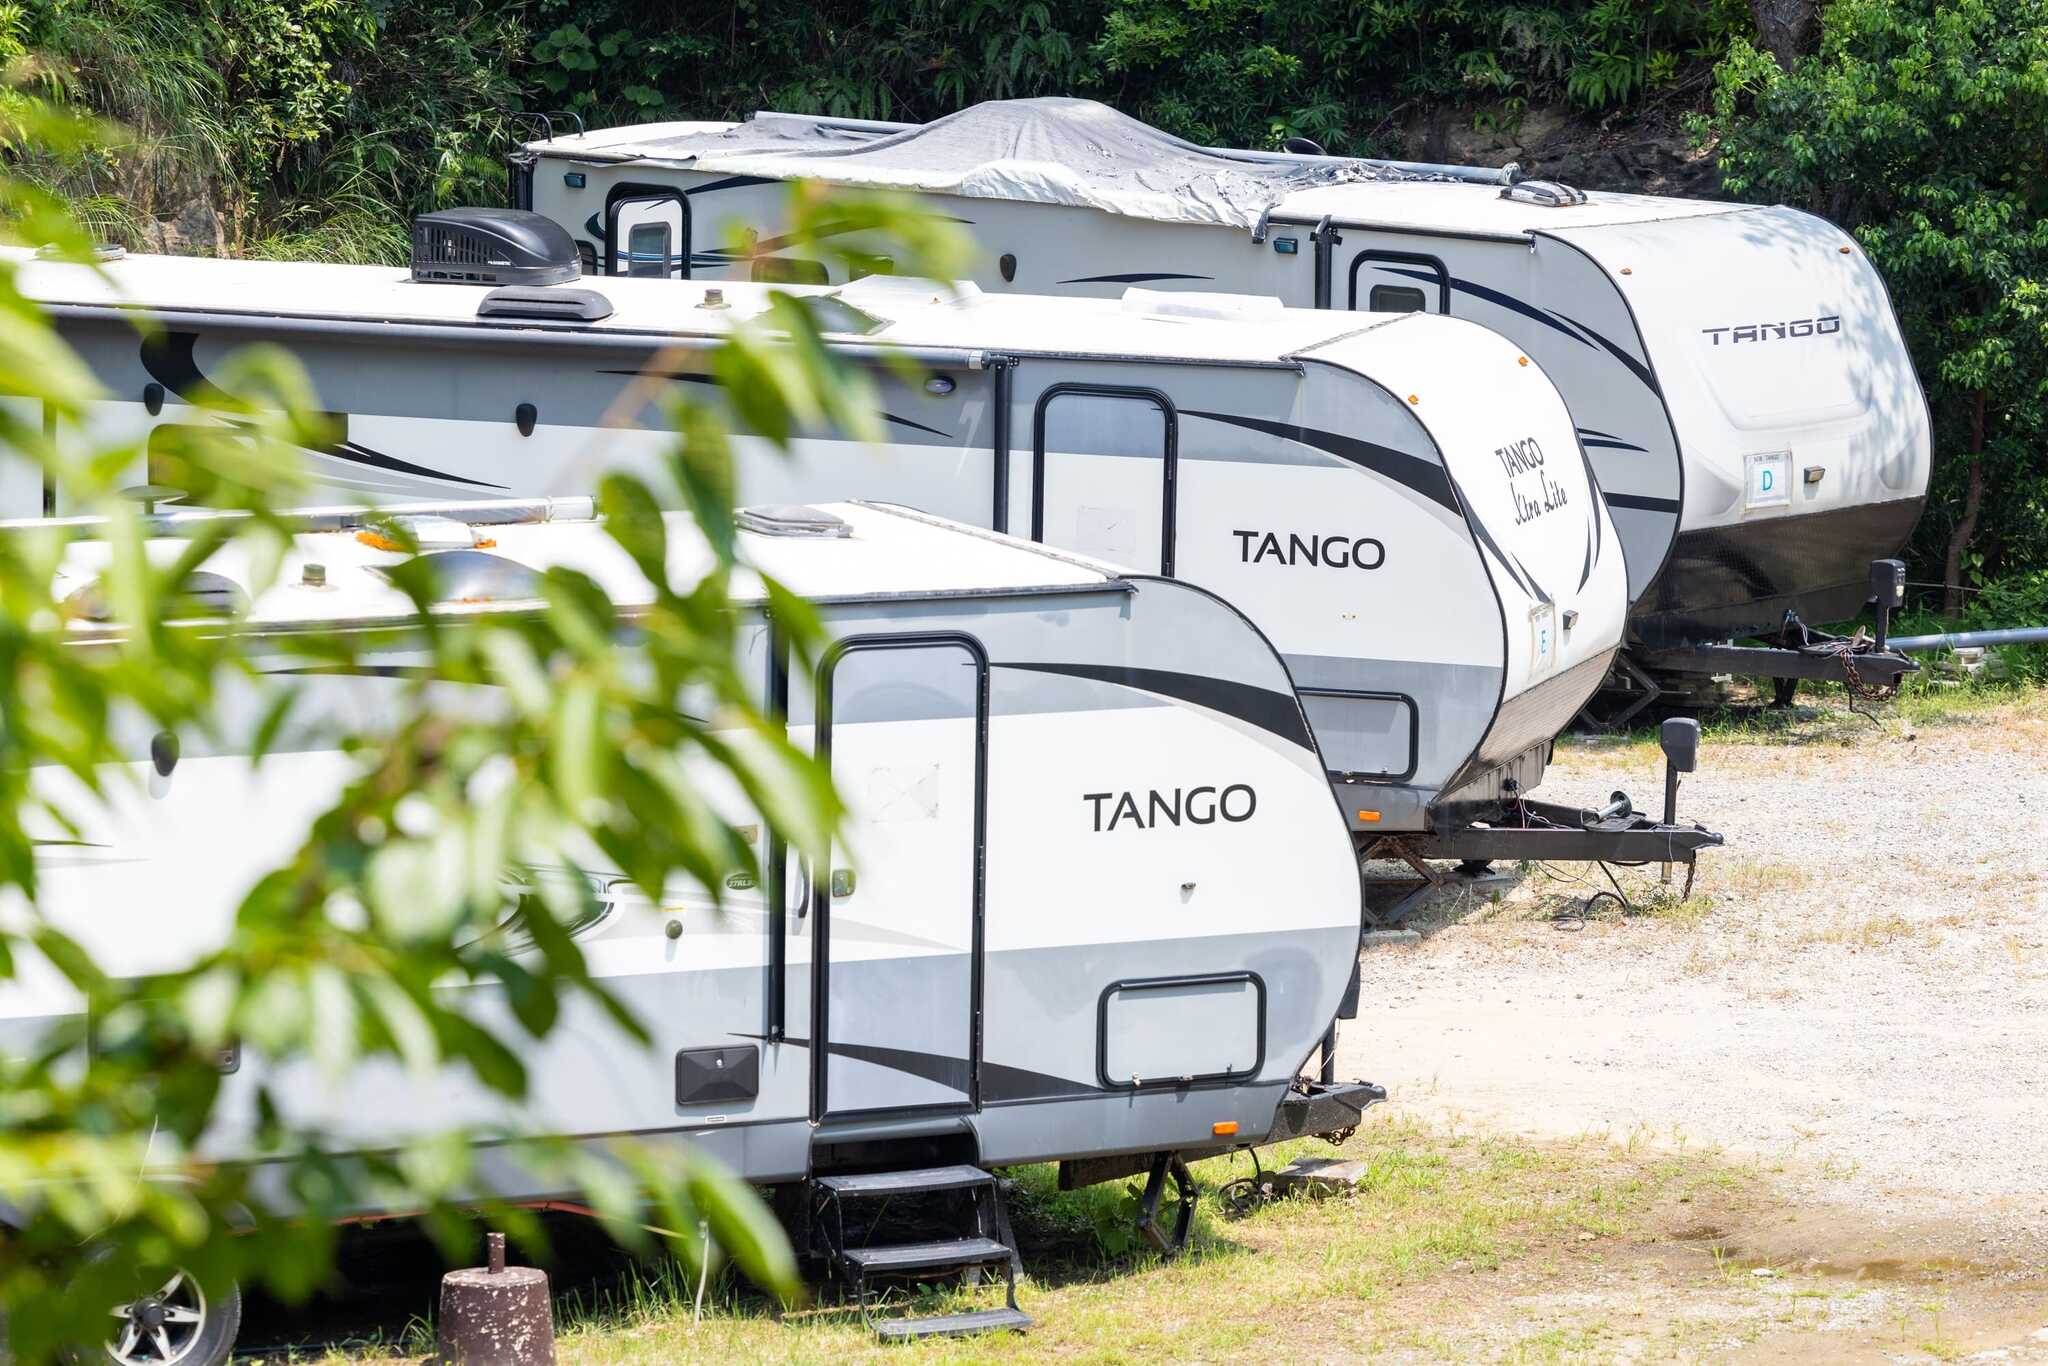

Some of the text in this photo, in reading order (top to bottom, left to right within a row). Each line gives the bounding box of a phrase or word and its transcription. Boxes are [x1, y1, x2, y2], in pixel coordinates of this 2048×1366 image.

[1702, 315, 1840, 345] TANGO
[1494, 437, 1544, 478] TANGO
[1510, 469, 1568, 525] Xtra Lite
[1762, 470, 1773, 491] D
[1232, 530, 1386, 571] TANGO
[1083, 784, 1257, 832] TANGO
